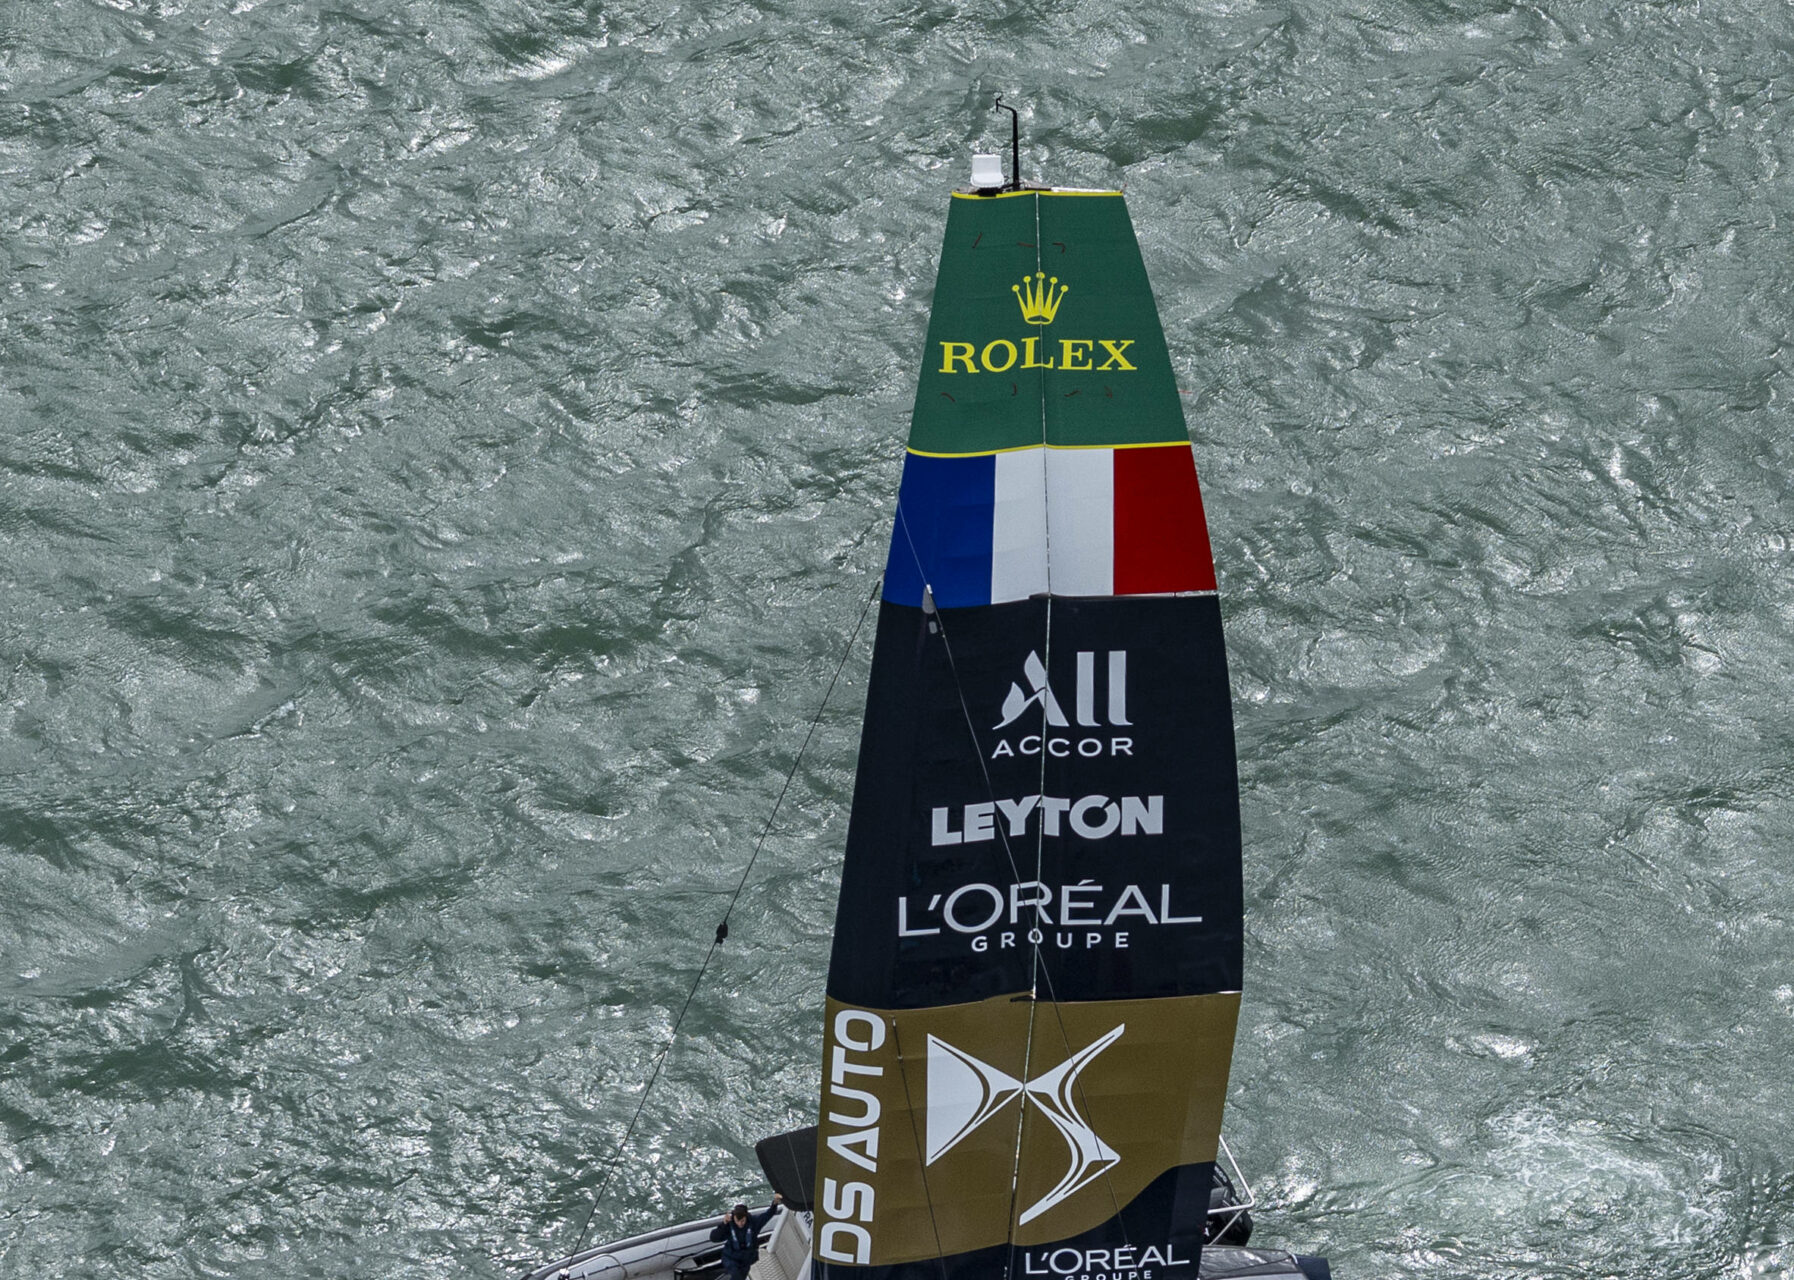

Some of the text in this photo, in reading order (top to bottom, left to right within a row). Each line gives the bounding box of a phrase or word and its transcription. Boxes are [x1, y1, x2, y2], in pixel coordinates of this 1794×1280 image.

[938, 336, 1137, 374] ROLEX
[991, 735, 1134, 759] ACCOR
[931, 795, 1164, 847] LEYTON
[898, 879, 1203, 937] L'ORÉAL
[971, 928, 1129, 952] GROUPE
[819, 1009, 887, 1265] DS AUTO
[1025, 1243, 1190, 1275] L'ORÉAL
